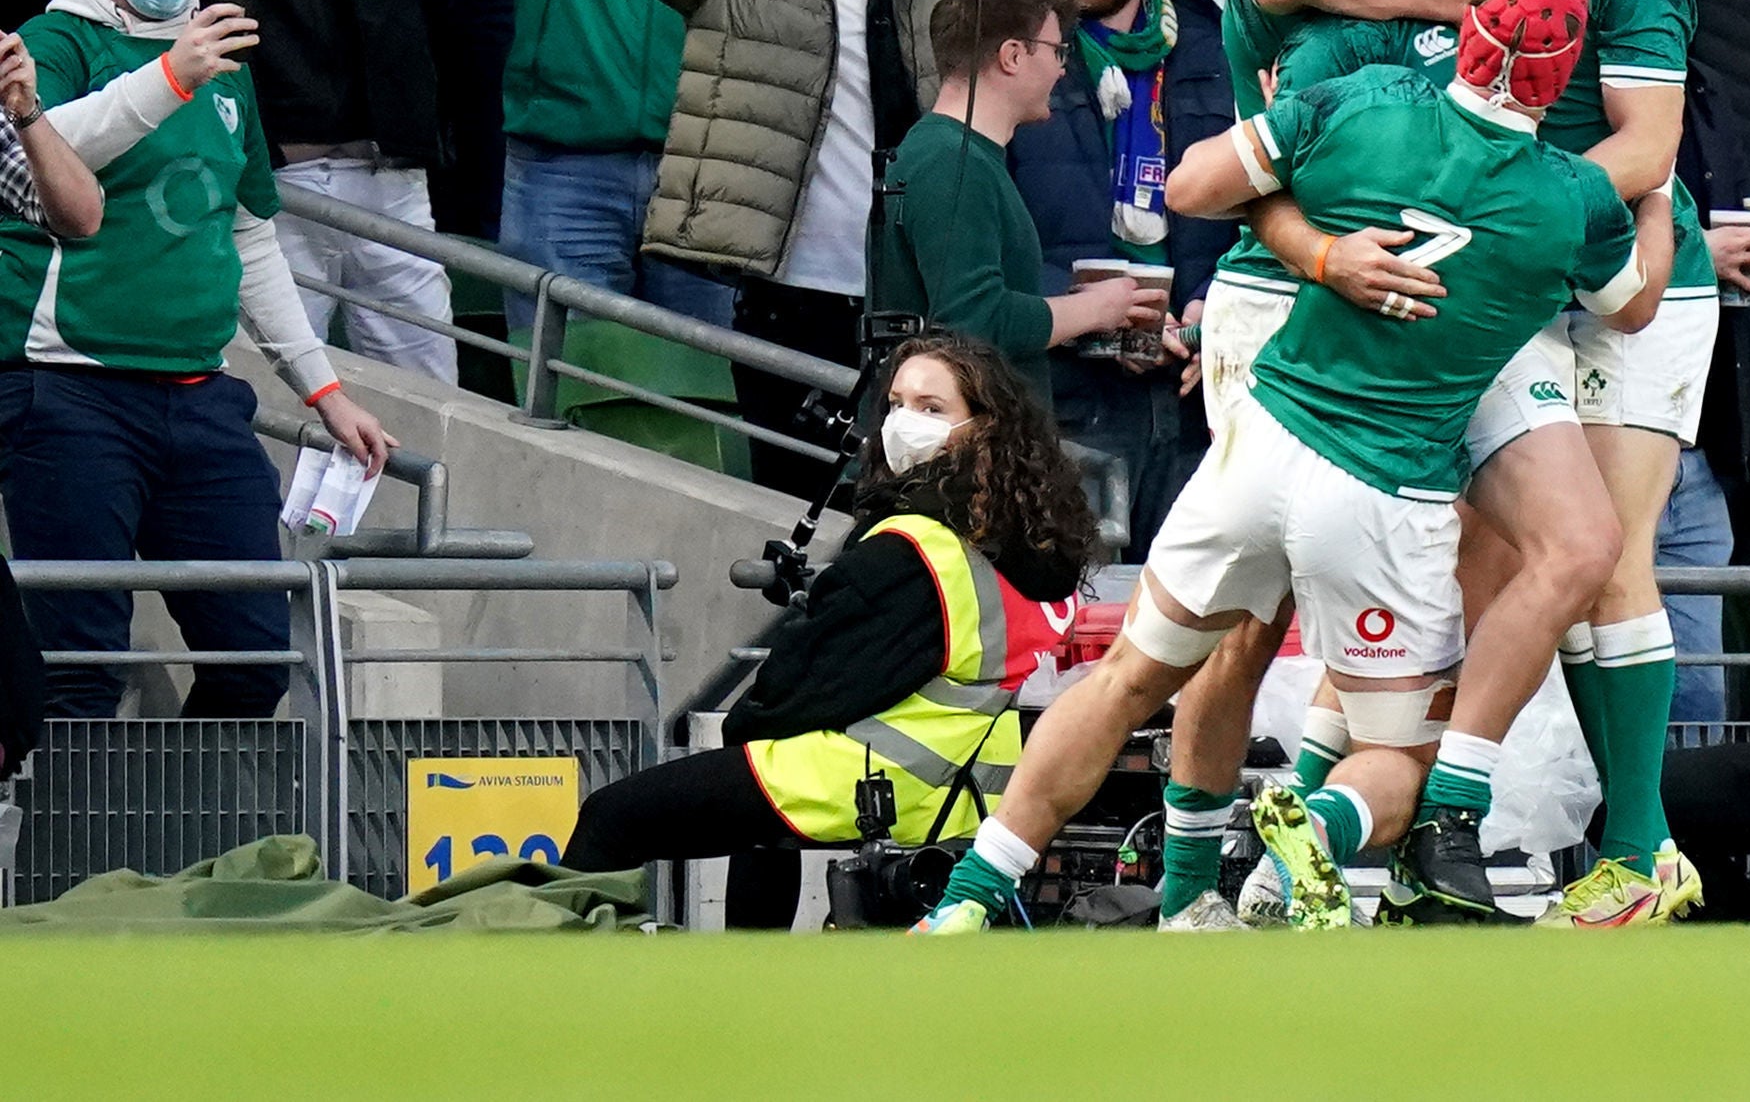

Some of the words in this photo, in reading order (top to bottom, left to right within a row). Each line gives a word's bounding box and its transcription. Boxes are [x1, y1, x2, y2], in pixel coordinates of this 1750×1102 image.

[1397, 208, 1472, 269] 7
[1343, 645, 1406, 658] vodafone
[478, 776, 511, 787] AVIVA
[512, 775, 564, 787] STADIUM
